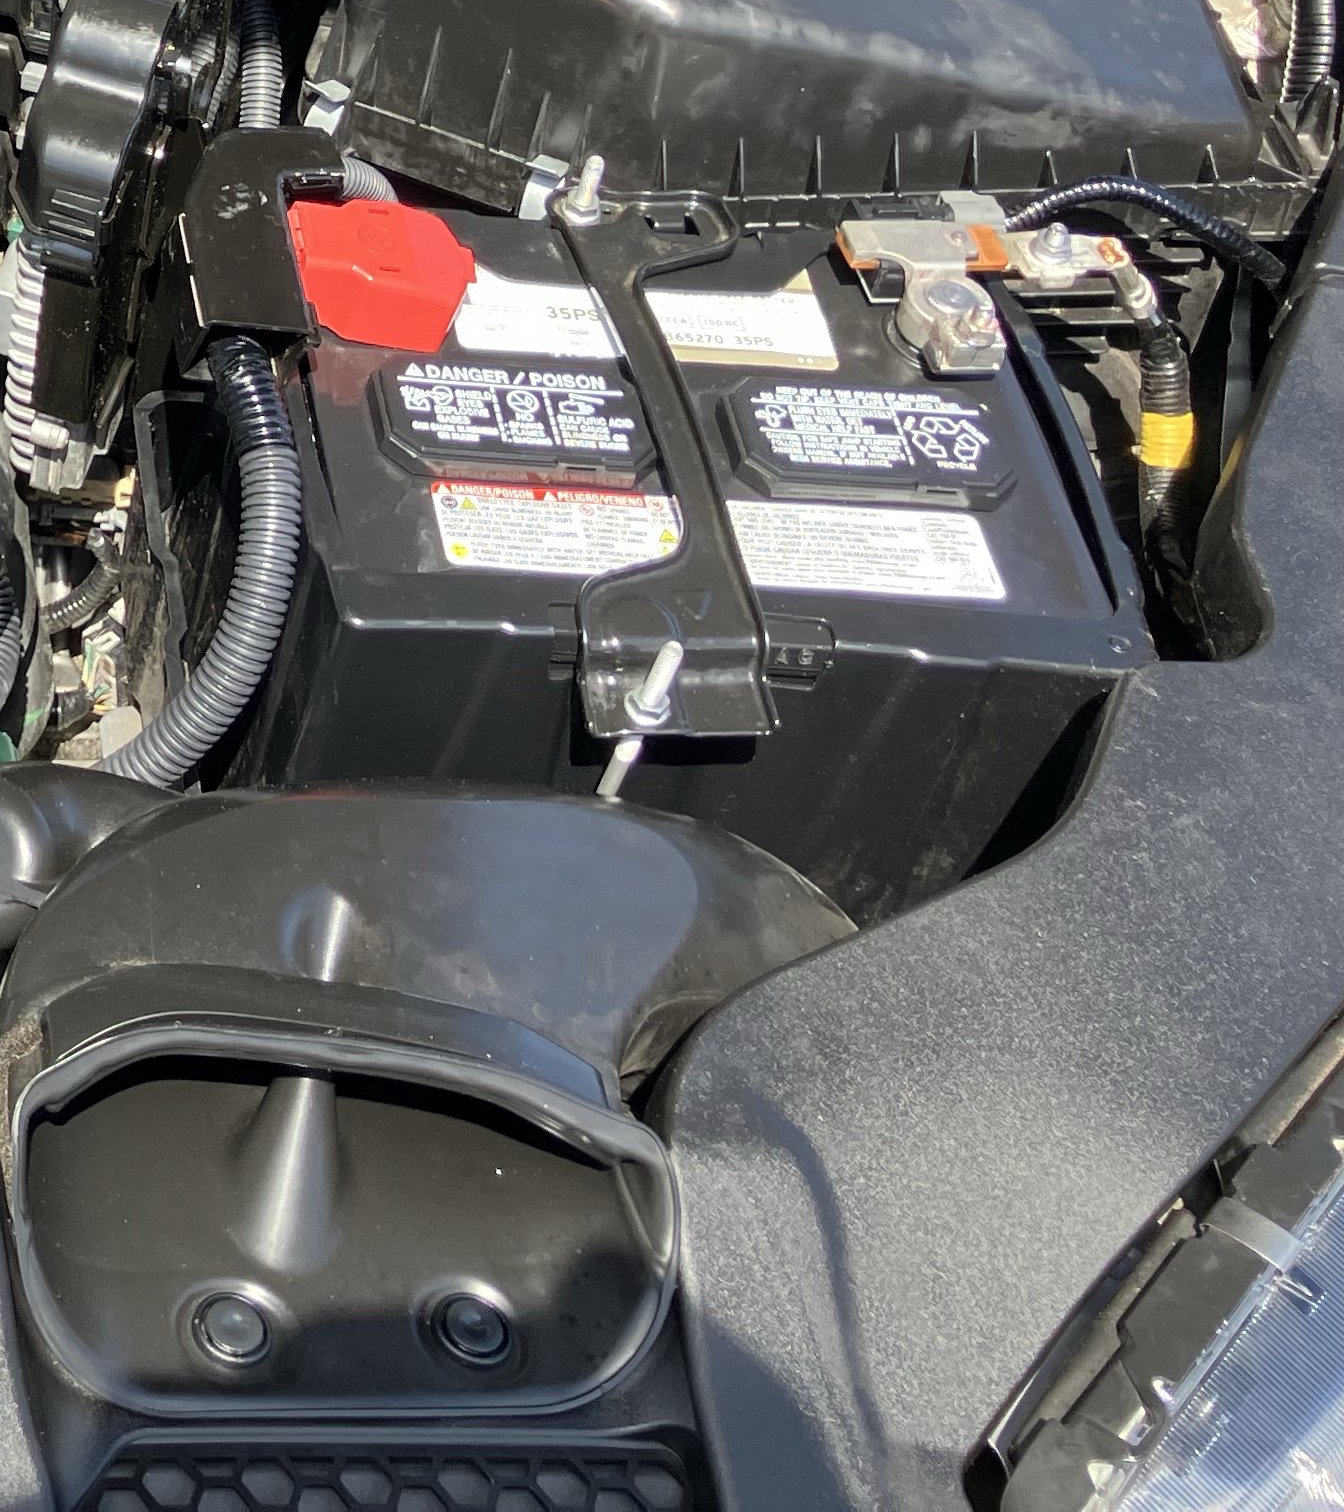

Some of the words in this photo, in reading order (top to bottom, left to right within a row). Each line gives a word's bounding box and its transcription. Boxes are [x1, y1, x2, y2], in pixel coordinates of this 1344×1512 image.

[545, 305, 602, 322] 35PS
[735, 335, 774, 348] 35PS
[424, 364, 510, 385] DANGER
[513, 371, 526, 385] /
[528, 372, 607, 390] POISON
[454, 388, 492, 401] SHIELD
[456, 399, 483, 408] EYES
[433, 405, 490, 418] EXPLOSIVE
[515, 412, 535, 422] NO
[557, 414, 607, 427] SULFURIC
[608, 417, 635, 429] ACID
